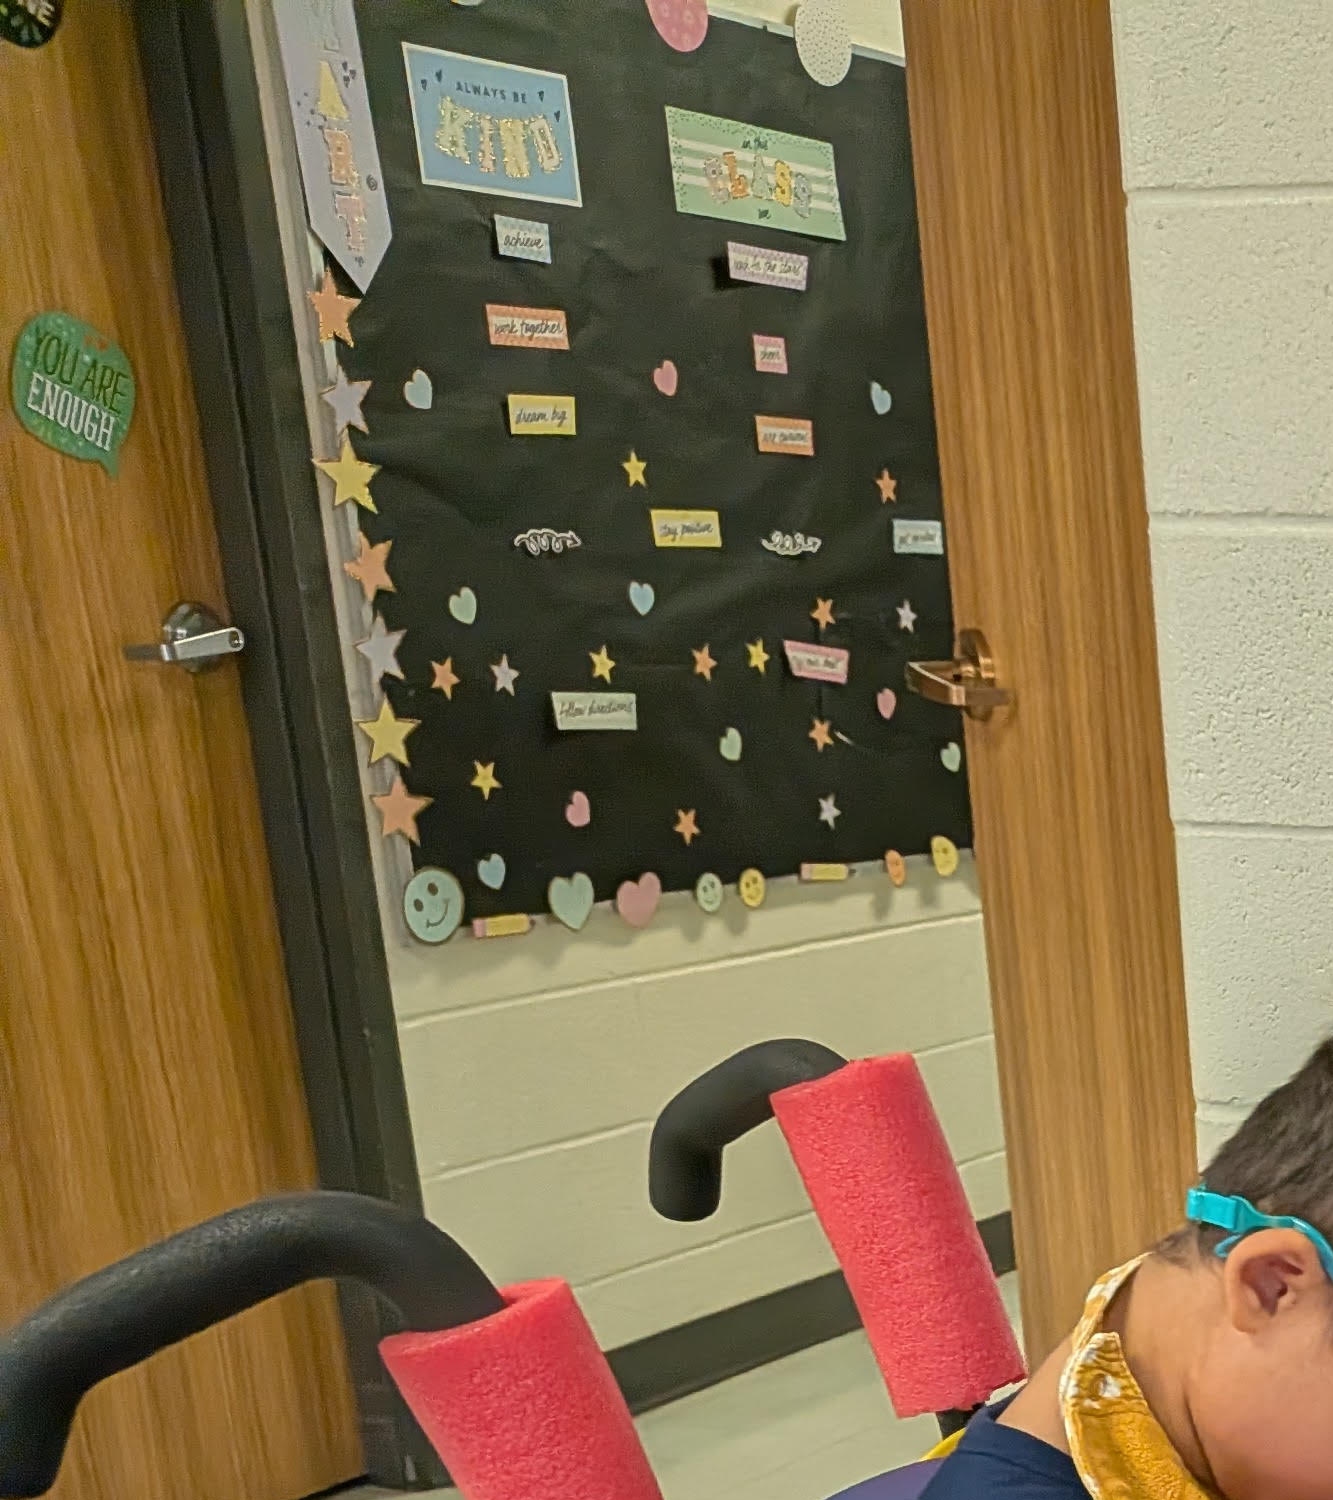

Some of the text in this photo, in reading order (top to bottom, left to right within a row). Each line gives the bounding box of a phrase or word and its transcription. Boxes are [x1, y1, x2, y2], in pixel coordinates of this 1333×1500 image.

[455, 81, 527, 104] ALWAYS BE
[434, 95, 563, 179] KIND
[503, 232, 544, 249] achieve
[494, 319, 563, 341] work together
[33, 327, 129, 414] YOU ARE
[27, 371, 116, 452] ENOUGH
[515, 407, 567, 428] dream big
